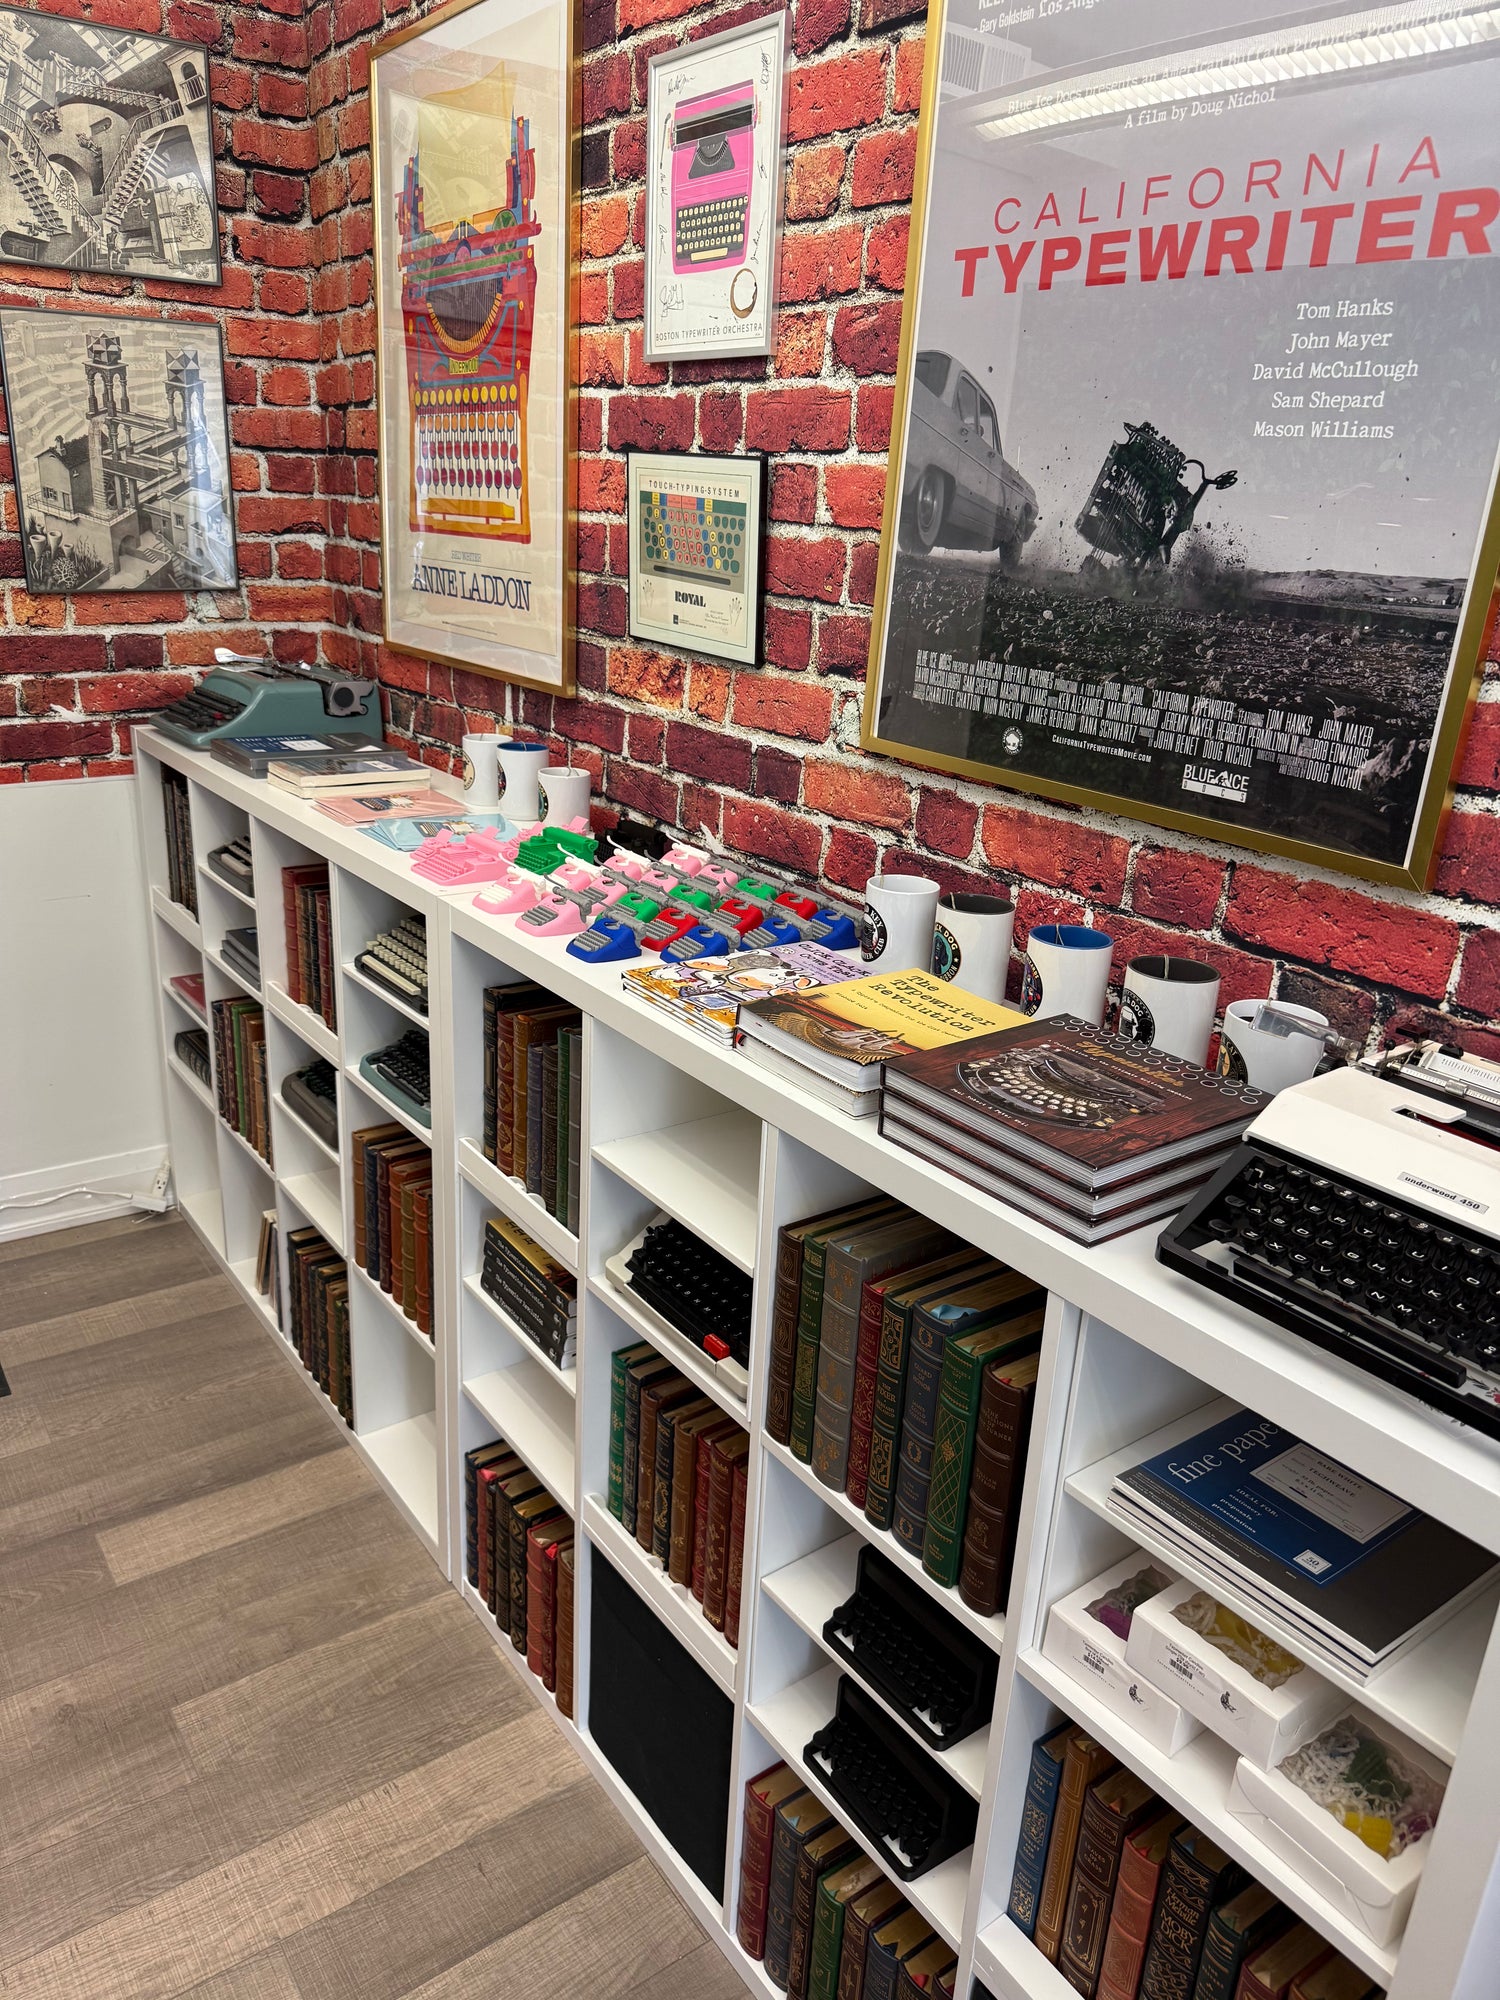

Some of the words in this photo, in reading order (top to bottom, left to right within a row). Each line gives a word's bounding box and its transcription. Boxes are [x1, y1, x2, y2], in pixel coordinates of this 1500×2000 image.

[980, 16, 997, 33] Gary
[998, 6, 1035, 28] Goldstein
[1008, 97, 1032, 114] Blue
[1036, 94, 1052, 109] Ice
[1055, 88, 1082, 105] Docs
[1124, 114, 1133, 129] A
[1136, 111, 1167, 127] film
[1171, 104, 1186, 120] by
[1191, 99, 1223, 118] Doug
[1227, 87, 1276, 111] Nichol
[994, 136, 1442, 235] CALIFORNIA
[954, 186, 1500, 298] TYPEWRITER
[1296, 302, 1330, 320] Tom
[1335, 298, 1394, 318] Hanks
[656, 331, 680, 342] BOSTON
[682, 326, 720, 339] TYPEWRITER
[723, 322, 763, 335] ORCHESTRA
[1286, 332, 1330, 354] John
[1335, 331, 1393, 350] Mayer
[1252, 362, 1304, 380] David
[1308, 359, 1419, 381] McCullough
[1271, 391, 1304, 408] Sam
[1308, 390, 1386, 412] Shepard
[1253, 421, 1304, 437] Mason
[1310, 420, 1394, 439] Williams
[649, 480, 740, 498] TOUCH-TYPING-SYSTEM
[412, 564, 458, 598] ANNE
[460, 571, 532, 611] LADDON
[675, 591, 706, 607] ROYAL
[1103, 681, 1120, 701] DOUG
[1122, 684, 1144, 705] NICHOL
[1266, 709, 1284, 731] TOM
[1285, 712, 1313, 736] HANKS
[1318, 719, 1342, 742] JOHN
[1343, 722, 1374, 748] MAYER
[1025, 705, 1049, 726] JAMES
[1049, 709, 1077, 731] REDFORD
[1079, 715, 1098, 736] DANA
[1099, 719, 1138, 744] SCHWARTZ
[1153, 730, 1175, 752] JOHN
[1175, 734, 1200, 756] BENET
[1202, 739, 1225, 761] DOUG
[1225, 743, 1254, 768] NICHOL
[1070, 693, 1105, 718] ALEXANDER
[1106, 700, 1131, 723] MARTIN
[1131, 705, 1159, 728] HOWARD
[1161, 711, 1189, 734] JEREMY
[1216, 721, 1247, 745] HERBERT
[1312, 739, 1329, 760] BOB
[1329, 742, 1370, 769] EDWARDS
[1183, 764, 1216, 784] BLUE
[1229, 773, 1250, 792] ICE
[1306, 760, 1331, 783] DOUG
[1331, 765, 1364, 791] NICHOL
[870, 910, 884, 928] KEY
[874, 938, 884, 955] CLUB
[944, 930, 958, 950] DOG
[906, 975, 940, 992] The
[869, 983, 974, 1032] Revolution
[889, 979, 996, 1026] Typewriter
[1404, 1176, 1457, 1200] underwood
[1459, 1199, 1481, 1210] 450
[877, 1385, 896, 1402] FIXER
[1167, 1454, 1222, 1484] fine
[1218, 1420, 1280, 1464] pape
[1338, 1472, 1363, 1490] WHITE
[1220, 1498, 1253, 1521] proposals
[1228, 1493, 1262, 1517] stationery
[1236, 1488, 1259, 1505] IDEAL
[1260, 1503, 1279, 1518] FOR:
[1212, 1503, 1257, 1534] presentations
[1306, 1556, 1320, 1567] 50
[1165, 1896, 1197, 1926] Melville
[1167, 1887, 1199, 1919] Herman
[1160, 1923, 1191, 1954] DICK
[1161, 1909, 1198, 1943] MOBY
